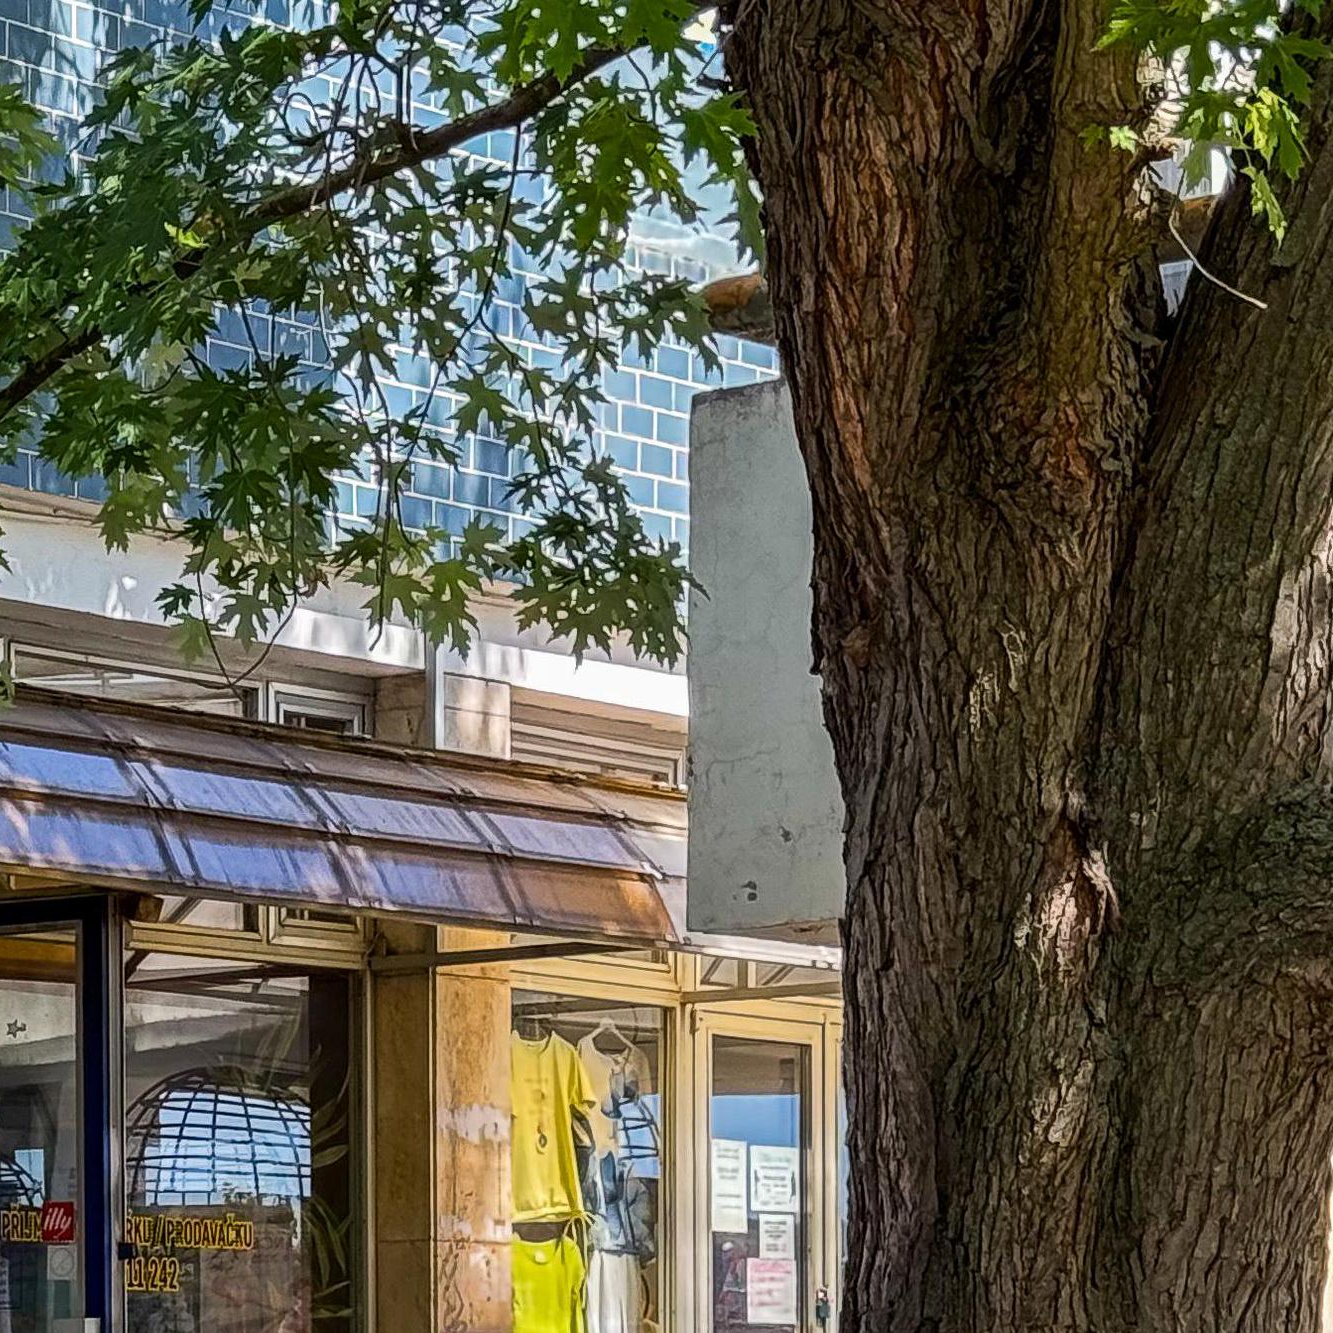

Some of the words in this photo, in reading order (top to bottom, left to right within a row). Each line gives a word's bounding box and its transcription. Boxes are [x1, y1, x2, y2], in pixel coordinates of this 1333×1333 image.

[44, 1206, 72, 1239] illy
[165, 1211, 254, 1250] PRODAVAČKU
[147, 1256, 180, 1292] 242
